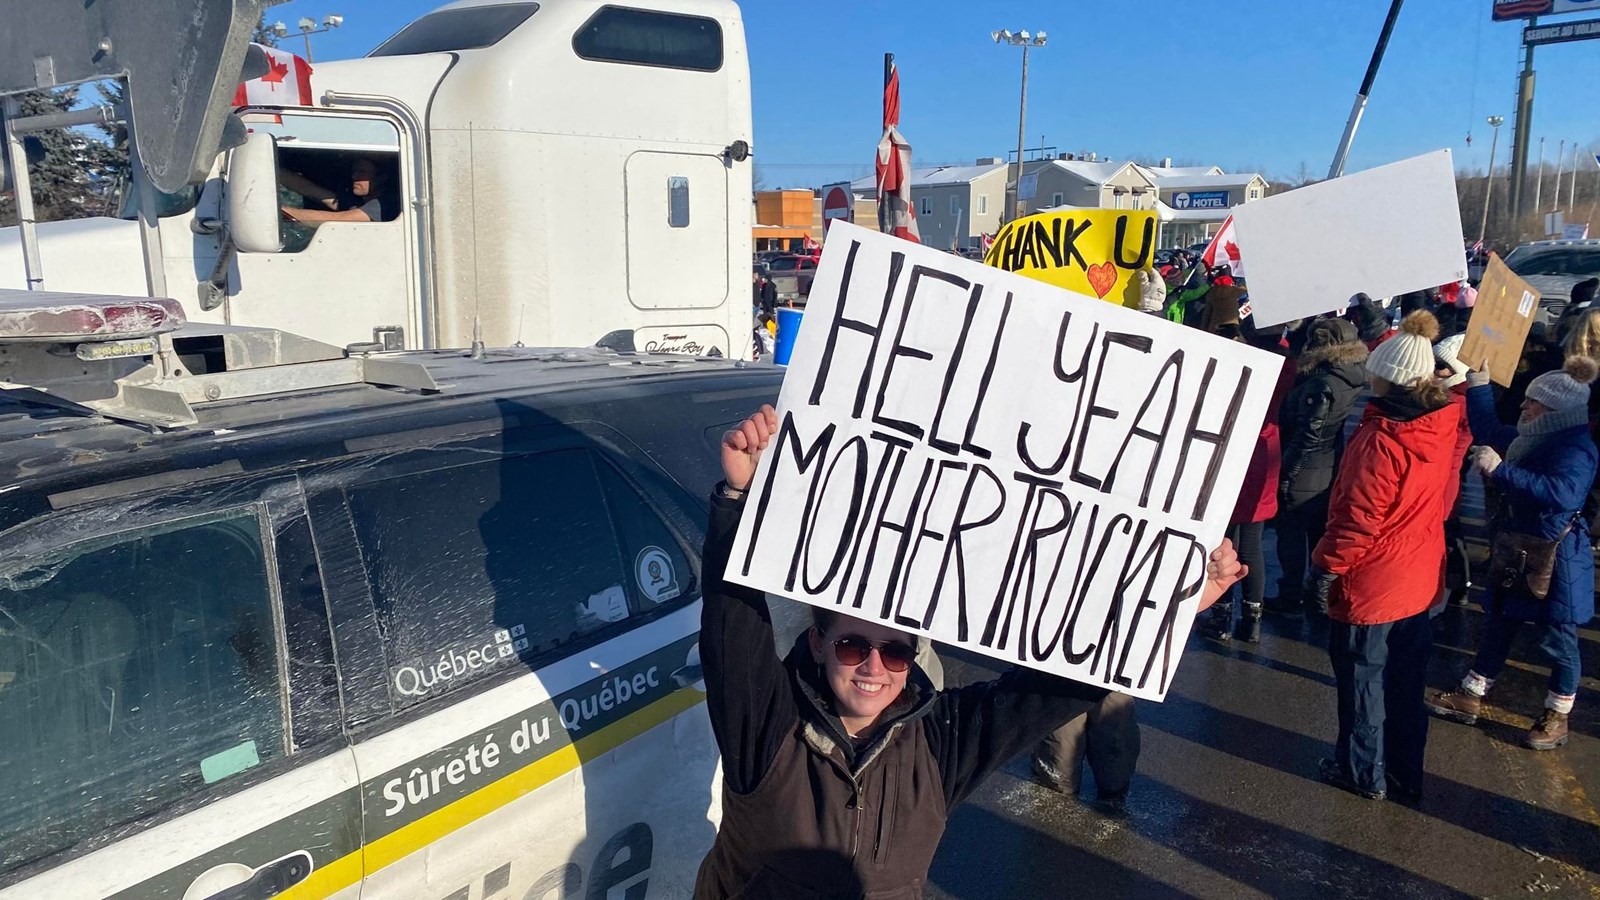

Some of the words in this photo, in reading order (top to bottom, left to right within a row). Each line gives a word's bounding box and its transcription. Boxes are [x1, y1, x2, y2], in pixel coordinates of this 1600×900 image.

[1193, 198, 1225, 207] HOTEL
[984, 218, 1093, 273] THANK
[1114, 215, 1154, 270] U
[808, 239, 1012, 460] HELL
[1017, 311, 1253, 522] YEAH
[395, 643, 496, 696] Québec
[383, 733, 500, 817] Sûreté
[510, 716, 551, 755] du
[559, 665, 660, 731] Québec
